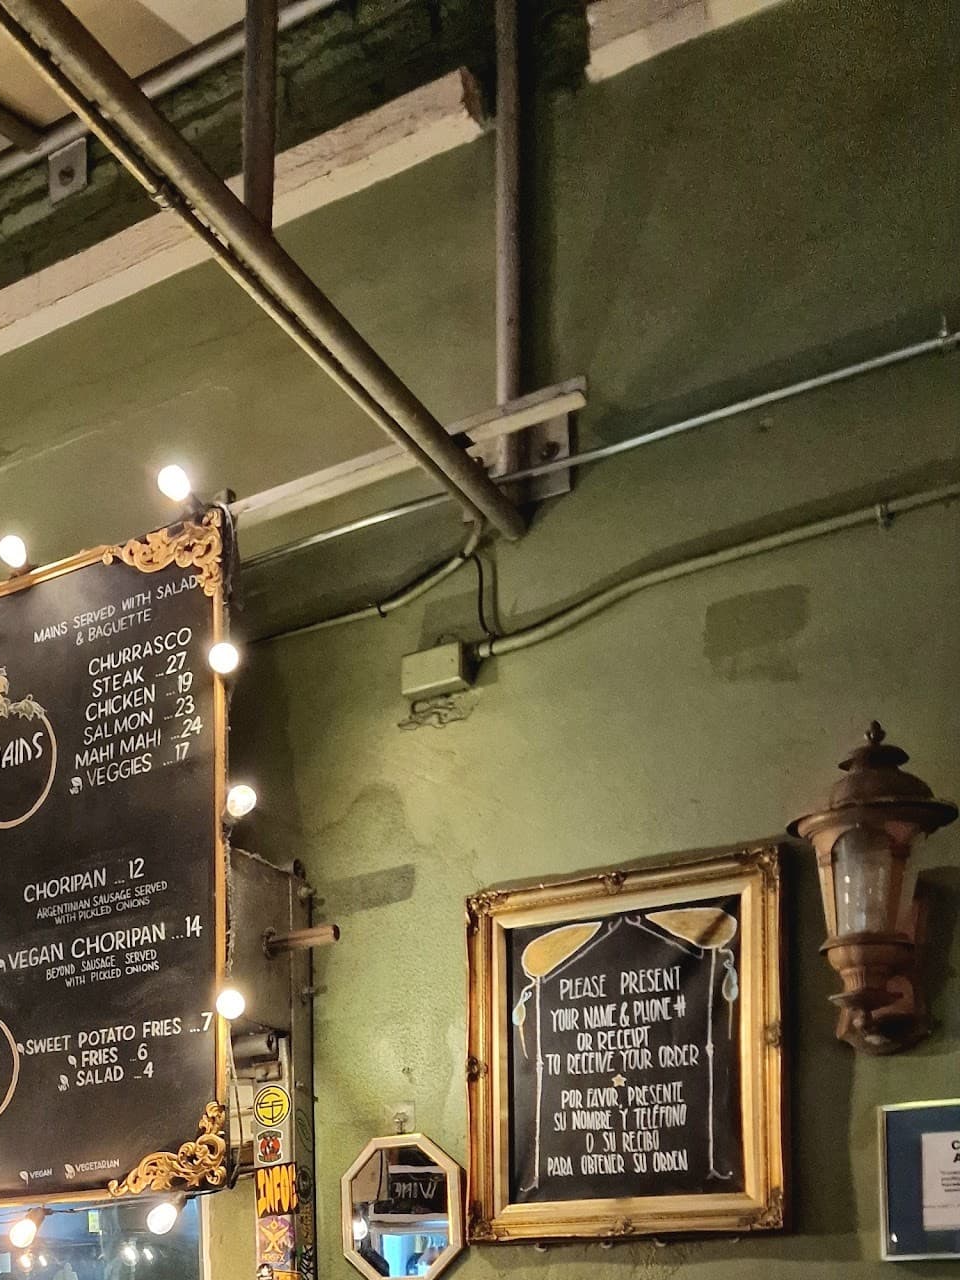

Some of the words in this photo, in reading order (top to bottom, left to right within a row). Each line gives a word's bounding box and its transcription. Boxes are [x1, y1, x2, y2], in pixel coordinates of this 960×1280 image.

[34, 622, 68, 643] MAINS
[73, 605, 116, 629] SERVED
[122, 590, 152, 611] WITH
[156, 574, 198, 599] SALAD
[76, 631, 84, 646] &
[88, 608, 152, 642] BAGUETTE
[88, 627, 192, 676] CHURRASCO
[92, 666, 144, 698] STEAK
[85, 684, 156, 722] CHICKEN
[83, 708, 153, 746] SALMON
[75, 743, 114, 770] MAHI
[120, 728, 161, 756] MAHI
[86, 753, 152, 787] VEGGIES
[23, 868, 107, 903] CHORIPAN
[36, 899, 91, 920] ARGENTINIAN
[93, 888, 132, 907] SAUSAGE
[134, 880, 168, 897] SERVED
[55, 913, 77, 926] WITH
[78, 906, 112, 923] PICKLED
[116, 897, 150, 911] ONIONS
[8, 942, 64, 971] VEGAN
[71, 922, 166, 959] CHORIPAN
[46, 964, 76, 981] BEYOND
[81, 955, 116, 973] SAUSAGE
[125, 949, 158, 965] SERVED
[65, 975, 86, 989] WITH
[90, 968, 122, 983] PICKLED
[125, 961, 160, 976] ONIONS
[559, 974, 607, 1000] PLEASE
[620, 966, 681, 995] PRESENT
[550, 1007, 579, 1032] YOUR
[583, 1003, 617, 1030] NAME
[620, 1001, 630, 1027] &
[633, 997, 673, 1024] PHONE
[673, 994, 686, 1018] #
[26, 1034, 72, 1057] SWEET
[78, 1025, 136, 1049] POTATO
[142, 1017, 183, 1039] FRIES
[577, 1032, 593, 1052] OR
[597, 1025, 651, 1050] RECEIPT
[81, 1046, 119, 1068] FRIES
[545, 1053, 561, 1075] TO
[567, 1050, 615, 1075] RECEIVE
[619, 1047, 654, 1072] YOUR
[658, 1043, 700, 1068] ORDER
[76, 1065, 125, 1087] SALAD
[561, 1089, 583, 1109] POR
[627, 1081, 684, 1105] PRESENTE
[554, 1111, 566, 1131] SU
[572, 1109, 612, 1131] NOMBRE
[619, 1107, 629, 1129] Y
[585, 1132, 594, 1154] O
[602, 1131, 617, 1152] SU
[622, 1129, 660, 1152] RECIBO
[29, 1168, 53, 1179] VEGAN
[74, 1159, 120, 1172] VEGETARIAN
[547, 1156, 573, 1177] PARA
[581, 1153, 625, 1175] OBTENER
[633, 1152, 647, 1173] SU
[652, 1149, 688, 1172] ORDEN
